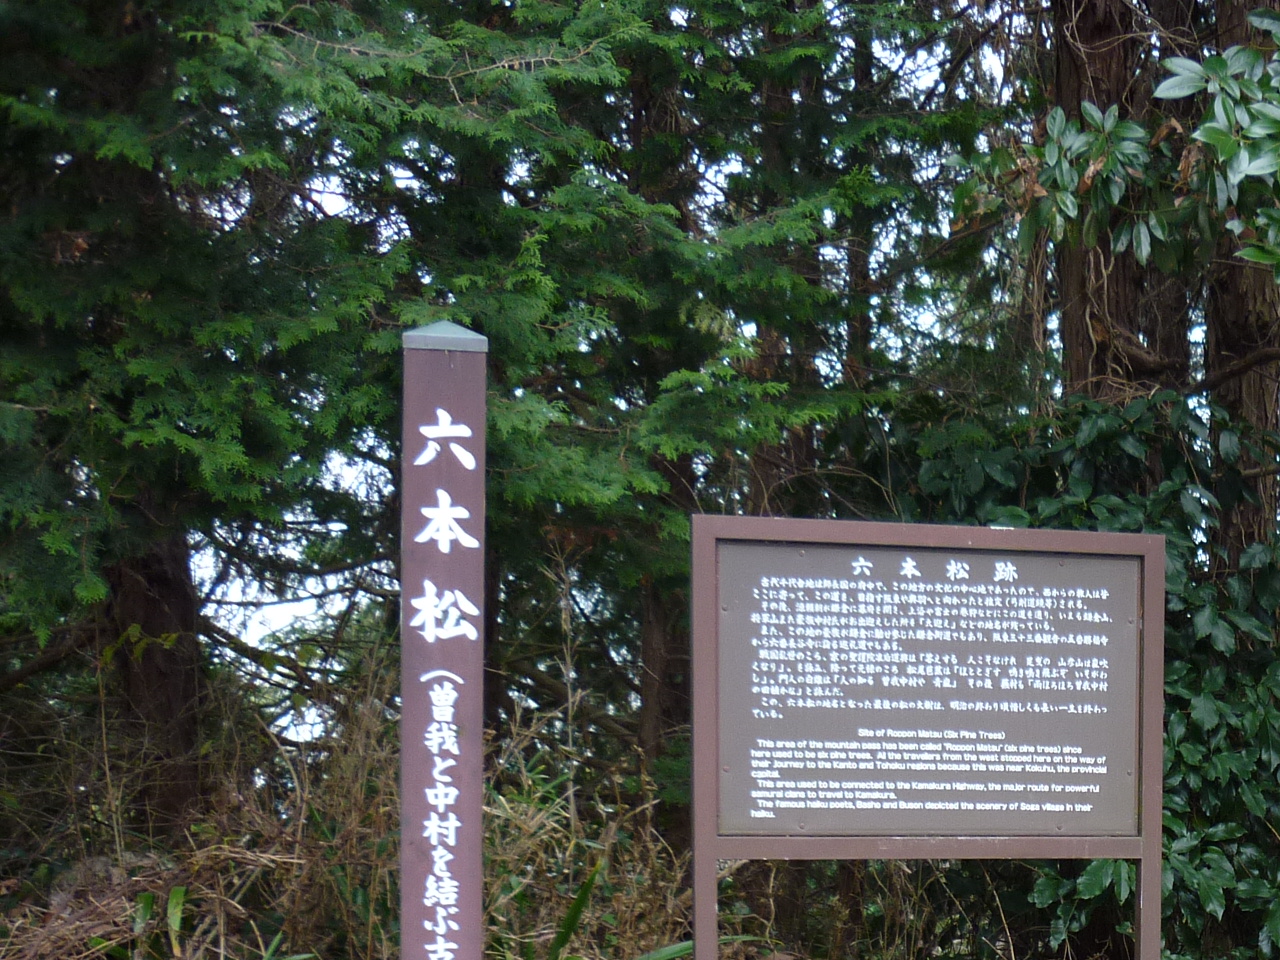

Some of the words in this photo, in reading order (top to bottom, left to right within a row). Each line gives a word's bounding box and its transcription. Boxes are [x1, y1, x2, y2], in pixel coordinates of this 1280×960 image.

[409, 407, 480, 643] 六本松
[857, 728, 874, 737] Site
[886, 729, 917, 739] Roppon
[917, 729, 942, 738] Matsu
[959, 730, 977, 739] Pine
[756, 739, 775, 748] This
[775, 740, 796, 748] area
[808, 740, 824, 749] the
[823, 740, 861, 749] mountain
[860, 742, 881, 751] pass
[881, 741, 897, 750] has
[897, 742, 919, 751] been
[1018, 744, 1035, 754] pine
[1062, 745, 1082, 754] since
[751, 749, 770, 758] here
[772, 750, 792, 759] used
[817, 750, 828, 760] six
[829, 751, 846, 761] pine
[848, 751, 872, 760] trees.
[887, 752, 901, 761] the
[942, 753, 962, 762] from
[963, 753, 977, 762] the
[978, 753, 998, 762] west
[1000, 754, 1031, 764] stopped
[1032, 754, 1051, 763] here
[1064, 755, 1077, 764] the
[1079, 756, 1095, 765] way
[751, 759, 770, 768] their
[773, 761, 804, 770] journey
[817, 760, 831, 769] the
[833, 761, 857, 770] Kanto
[858, 761, 874, 770] and
[876, 761, 905, 771] Tohoku
[937, 762, 970, 772] because
[972, 763, 986, 772] this
[988, 764, 1004, 772] was
[1057, 764, 1069, 773] the
[751, 789, 783, 798] samurai
[784, 790, 805, 799] clans
[818, 790, 843, 799] travel
[757, 780, 774, 789] This
[775, 781, 795, 789] area
[796, 780, 817, 789] used
[841, 781, 884, 790] connected
[896, 781, 910, 791] the
[911, 782, 951, 791] Kamakura
[987, 783, 1001, 792] the
[1002, 784, 1025, 793] major
[1027, 783, 1049, 792] route
[1051, 783, 1063, 793] for
[1065, 784, 1099, 794] powerful
[757, 799, 773, 808] The
[775, 799, 805, 809] famous
[806, 800, 828, 809] haiku
[855, 800, 881, 810] Basho
[882, 801, 897, 810] and
[924, 801, 959, 811] depicted
[960, 802, 974, 811] the
[975, 803, 1007, 812] scenery
[1020, 802, 1040, 812] Soga
[1074, 803, 1092, 812] their
